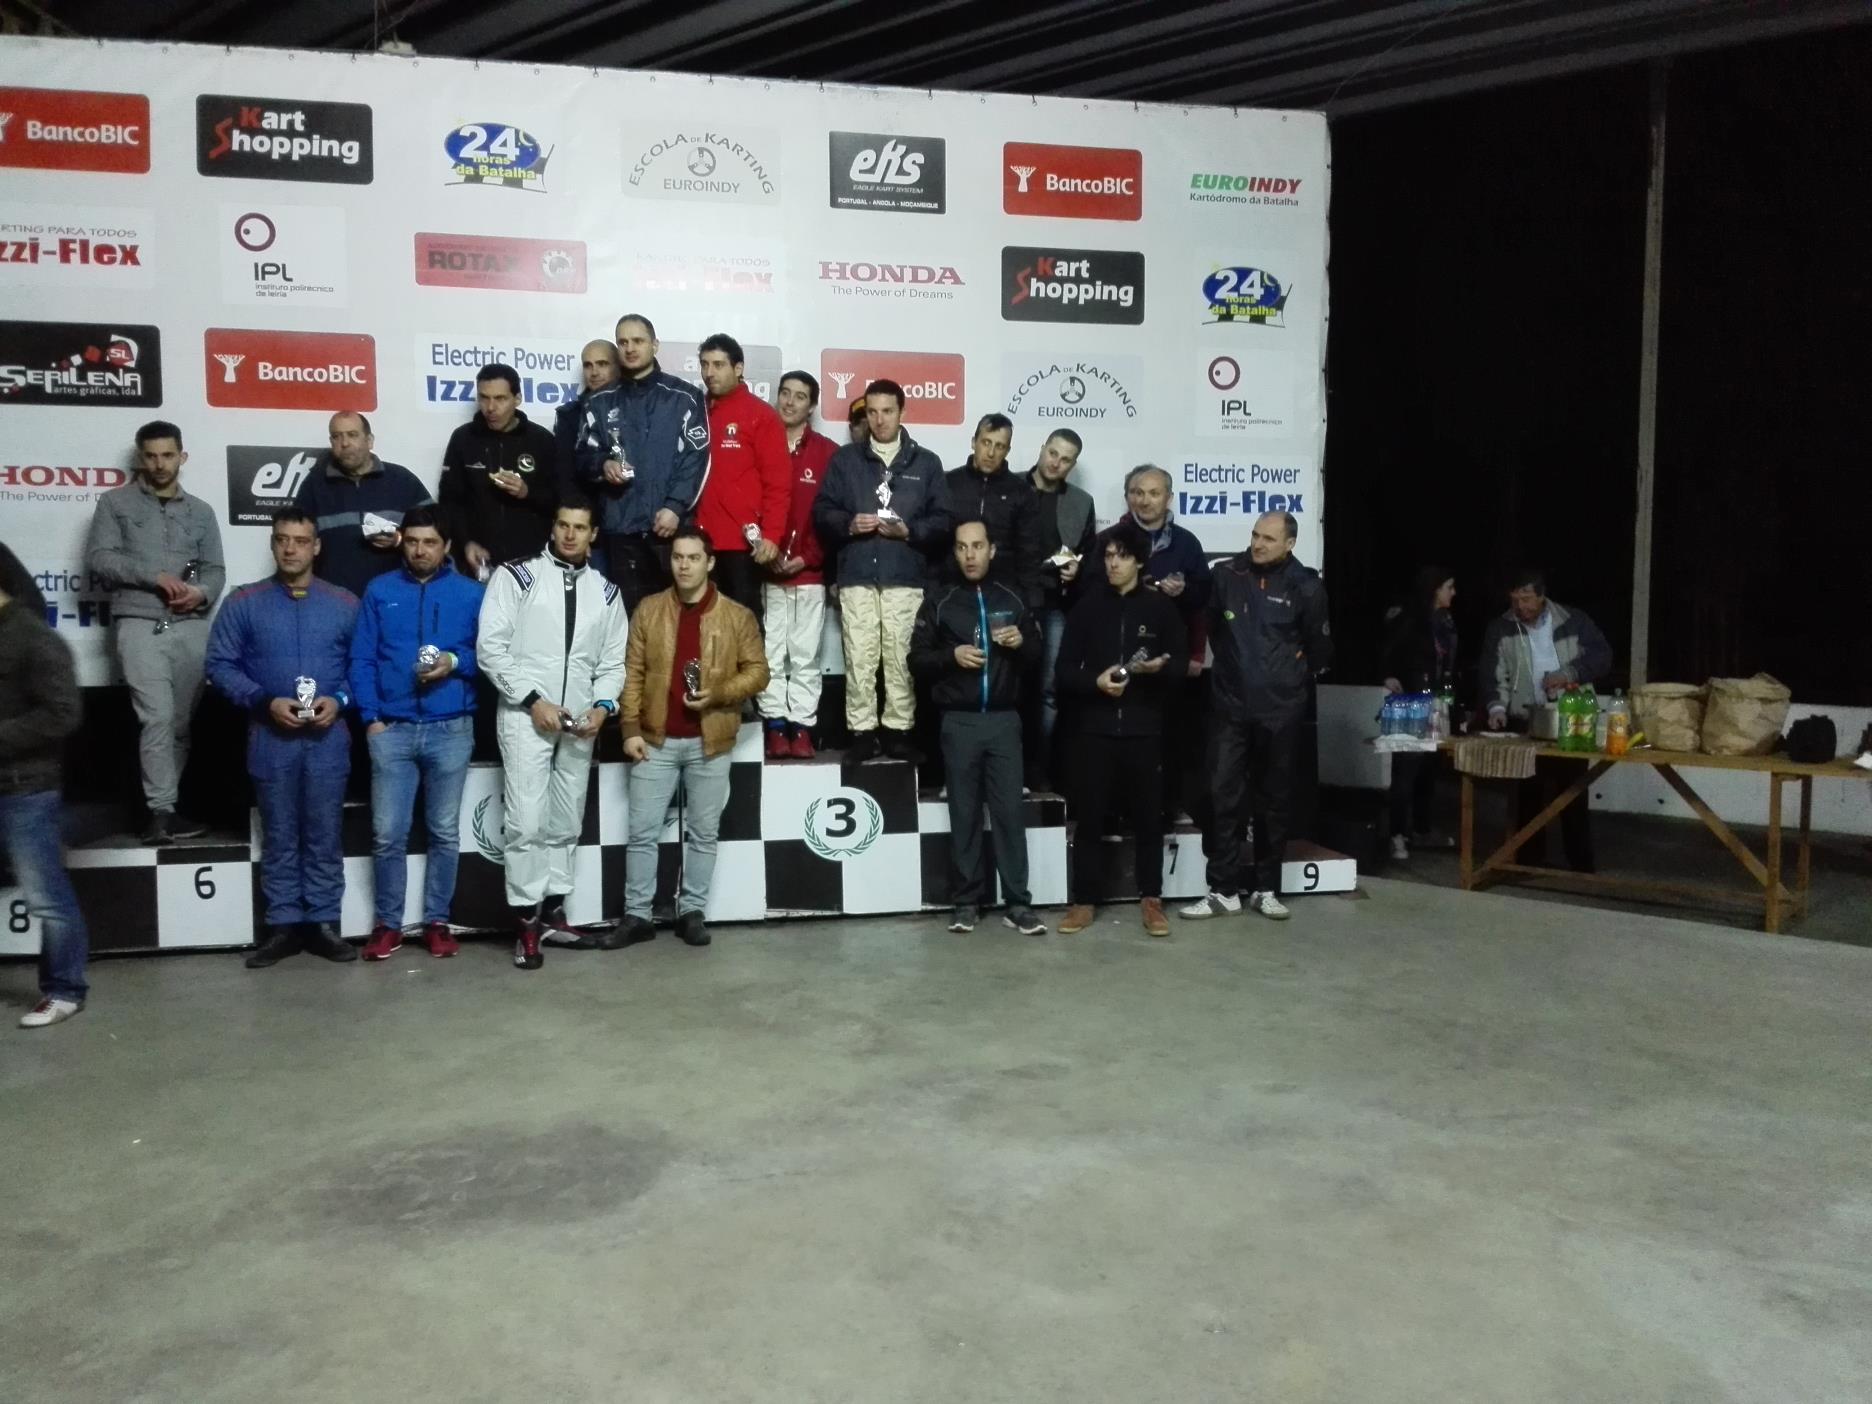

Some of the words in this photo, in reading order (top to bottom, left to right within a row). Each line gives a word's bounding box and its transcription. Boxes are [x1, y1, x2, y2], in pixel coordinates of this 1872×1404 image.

[240, 106, 305, 131] Kart
[27, 120, 139, 145] BancoBIC
[208, 117, 360, 164] Shopping
[459, 126, 520, 160] 24
[456, 164, 474, 175] da
[479, 165, 536, 180] Batalha
[629, 133, 688, 187] ESCOLA
[704, 132, 775, 195] KARTING
[664, 178, 740, 193] EUROINDY
[1046, 173, 1134, 196] BancoBIC
[1190, 173, 1302, 194] EUROINDY
[838, 197, 867, 205] PORTUGAL
[872, 199, 896, 207] ANGOLA
[1190, 193, 1247, 204] Kartódromo
[1249, 195, 1261, 205] da
[1263, 196, 1299, 206] Batalha
[48, 226, 86, 236] PARA
[89, 228, 137, 238] TODOS
[254, 262, 293, 282] IPL
[819, 260, 966, 285] HONDA
[1038, 257, 1090, 278] Kart
[831, 285, 852, 297] The
[855, 285, 891, 298] Power
[894, 286, 908, 298] of
[909, 288, 954, 300] Dreams
[1010, 267, 1134, 307] Shopping
[1214, 269, 1265, 300] 24
[1211, 305, 1226, 315] da
[1230, 305, 1277, 316] Batalha
[432, 343, 506, 367] Electric
[514, 347, 575, 371] Power
[258, 361, 367, 385] BancoBIC
[53, 386, 77, 394] artes
[426, 375, 580, 403] Izzlex
[866, 379, 956, 399] coBIC
[1007, 364, 1061, 414] ESCOLA
[1076, 363, 1137, 418] KARTING
[1038, 406, 1107, 418] EUROINDY
[1221, 399, 1251, 416] IPL
[0, 465, 126, 487] HOND
[1184, 463, 1245, 484] Electric
[1251, 464, 1300, 484] Power
[0, 490, 24, 501] The
[28, 491, 72, 502] Power
[75, 492, 90, 502] of
[1179, 490, 1304, 515] Izzi-Flex
[825, 797, 857, 838] 3
[1168, 843, 1179, 875] 7
[194, 866, 216, 900] 6
[1303, 862, 1320, 891] 9
[9, 900, 30, 933] 8
